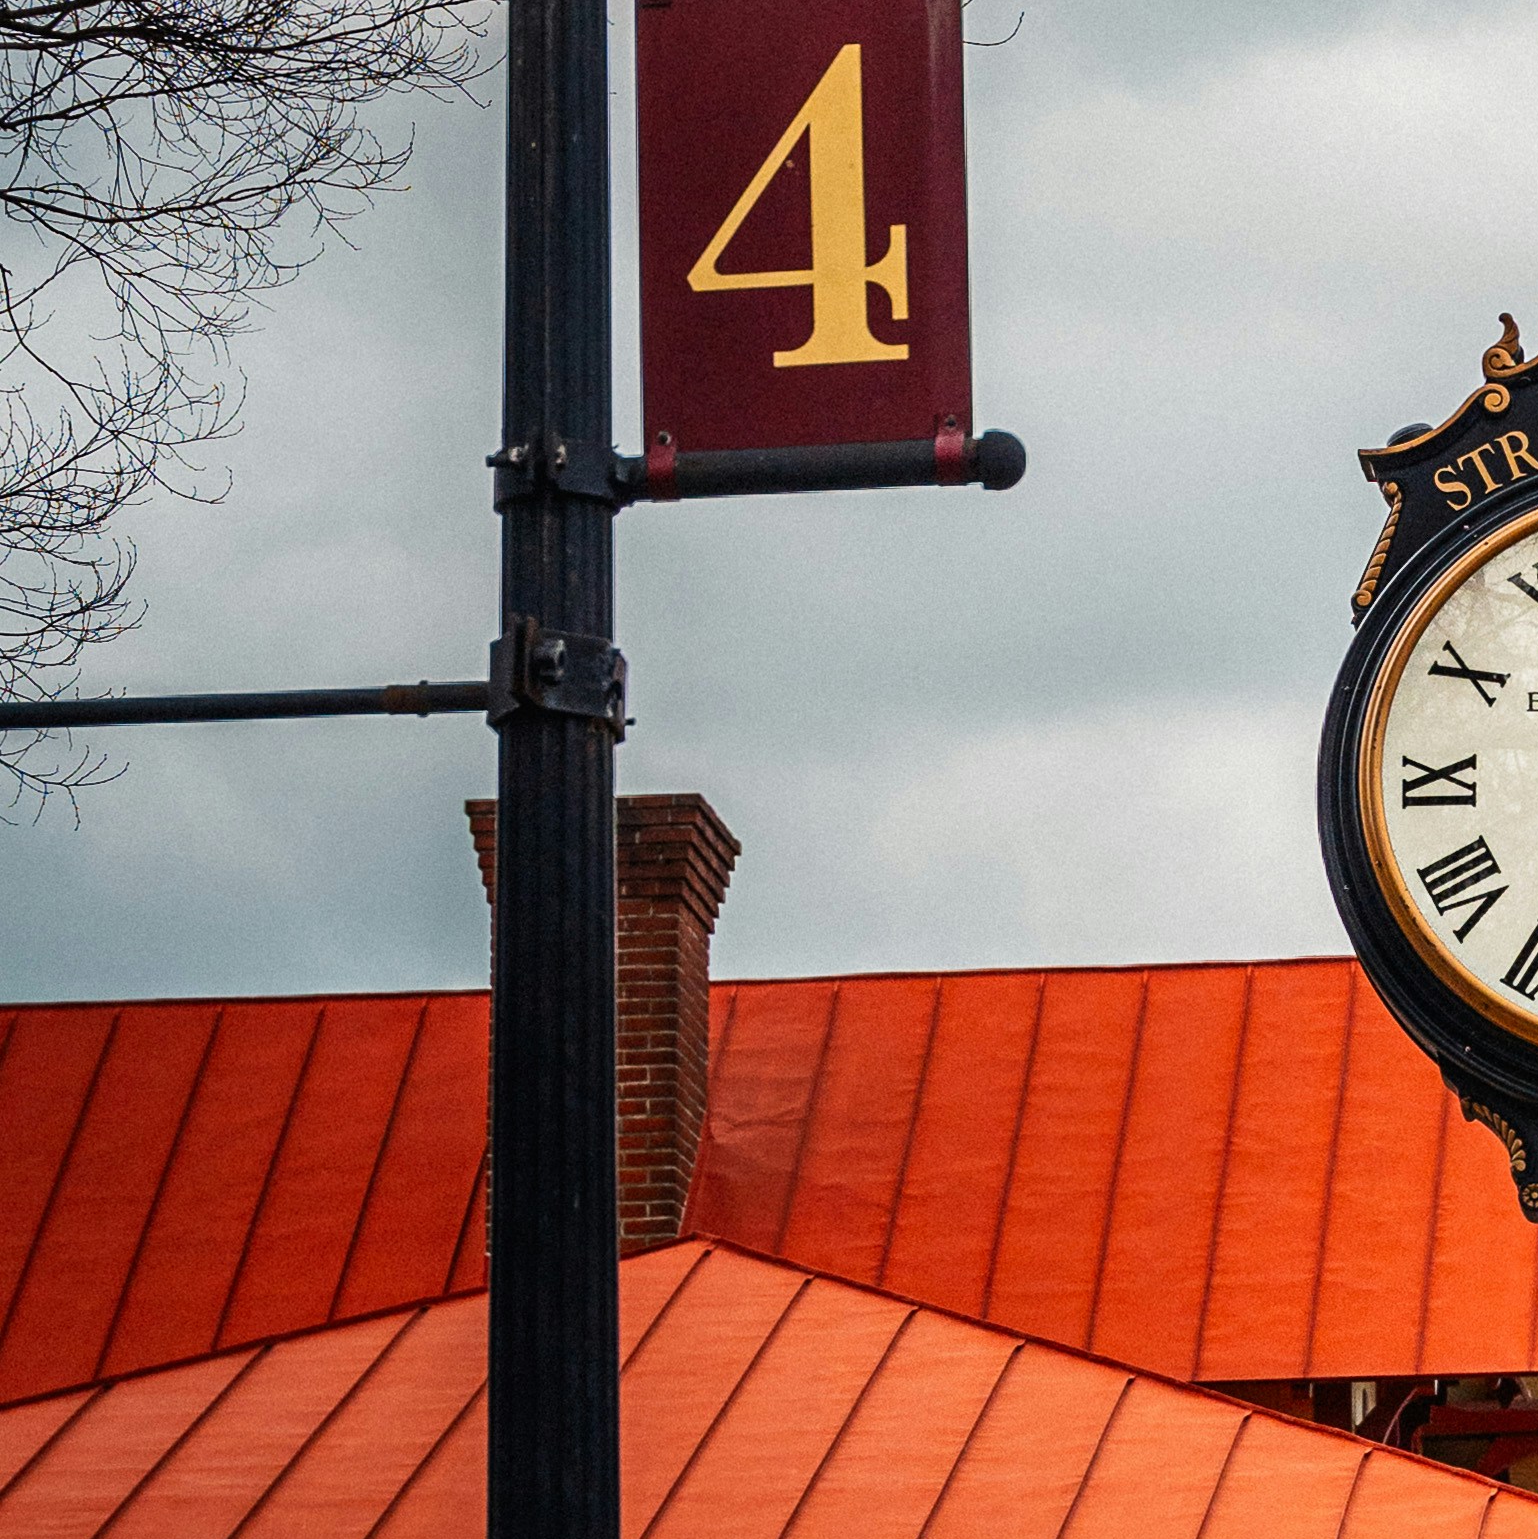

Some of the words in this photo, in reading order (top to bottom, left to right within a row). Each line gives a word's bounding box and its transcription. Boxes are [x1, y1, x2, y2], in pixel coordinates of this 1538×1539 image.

[686, 43, 910, 368] 4
[1427, 640, 1511, 708] X
[1402, 753, 1477, 809] IX
[1416, 834, 1510, 945] VIII
